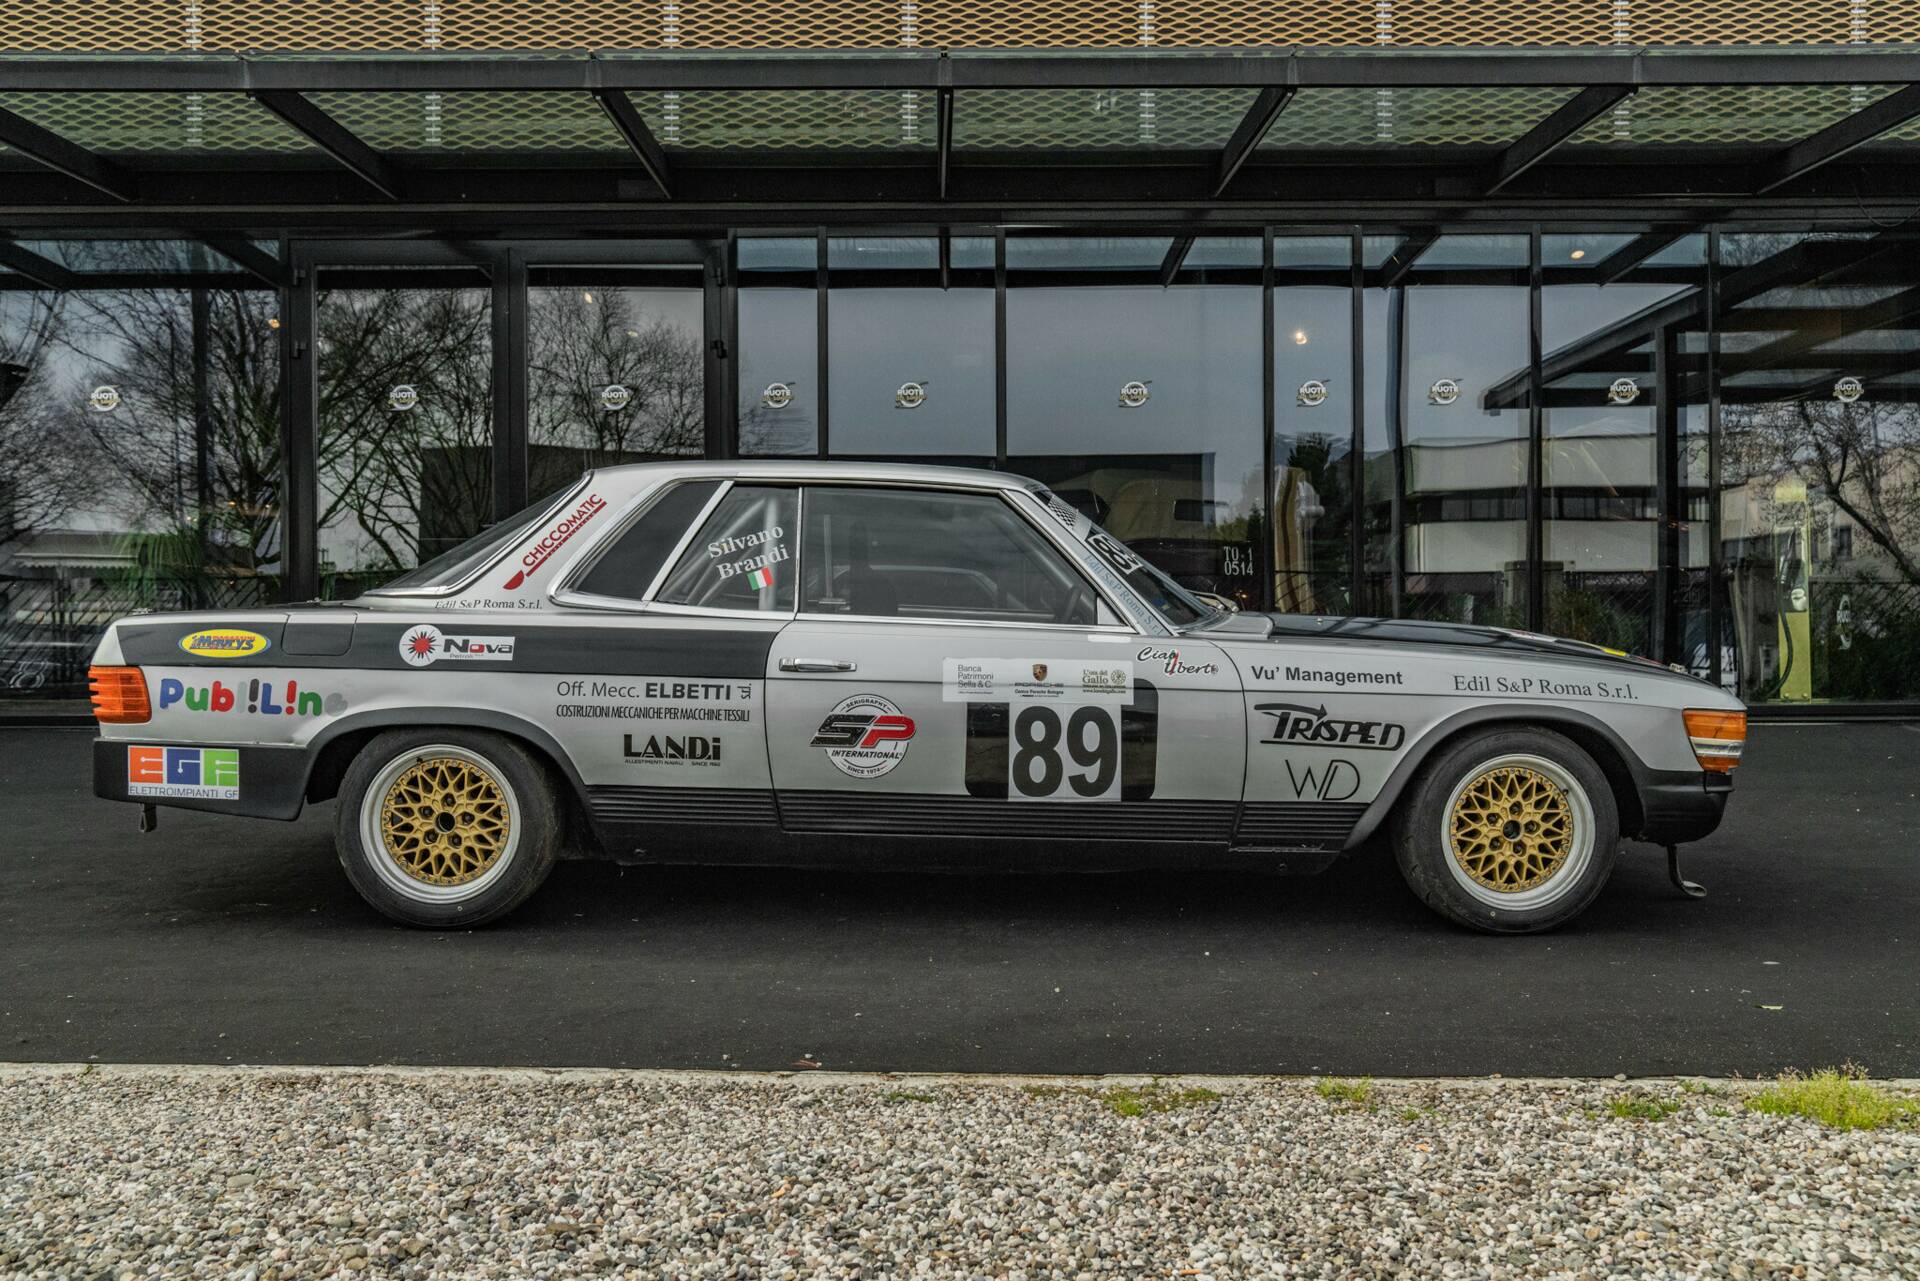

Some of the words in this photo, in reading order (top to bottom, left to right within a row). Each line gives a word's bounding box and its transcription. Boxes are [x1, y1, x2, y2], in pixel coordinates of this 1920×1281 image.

[522, 493, 603, 566] CHICCOMATIC
[707, 526, 784, 558] Silvano
[716, 544, 790, 580] Brandi
[1224, 560, 1254, 576] 0514
[483, 599, 515, 609] Roma
[517, 599, 543, 610] S.r.l.
[443, 638, 513, 653] Nova
[1137, 646, 1176, 661] Ciao
[958, 664, 982, 672] Banca
[958, 672, 994, 680] Patrimoni
[1285, 666, 1403, 686] Management
[1082, 675, 1109, 685] Gallo
[1453, 675, 1490, 692] Edil
[1496, 677, 1533, 694] S&P
[1540, 679, 1592, 697] Roma
[1598, 682, 1639, 700] S.r.l.
[557, 681, 587, 697] Off.
[591, 681, 640, 698] Mecc.
[645, 682, 732, 701] ELBETTI
[556, 703, 610, 718] COSTRUZIONI
[611, 705, 663, 719] MECCANICHE
[664, 707, 679, 720] PER
[680, 708, 722, 721] MACCHINE
[723, 709, 750, 723] TESSILI
[831, 749, 900, 760] INTERNATIONAL
[1012, 705, 1118, 798] 89
[1285, 758, 1361, 802] WD
[129, 786, 218, 798] ELETTROIMPIANTI
[224, 790, 239, 799] GF
